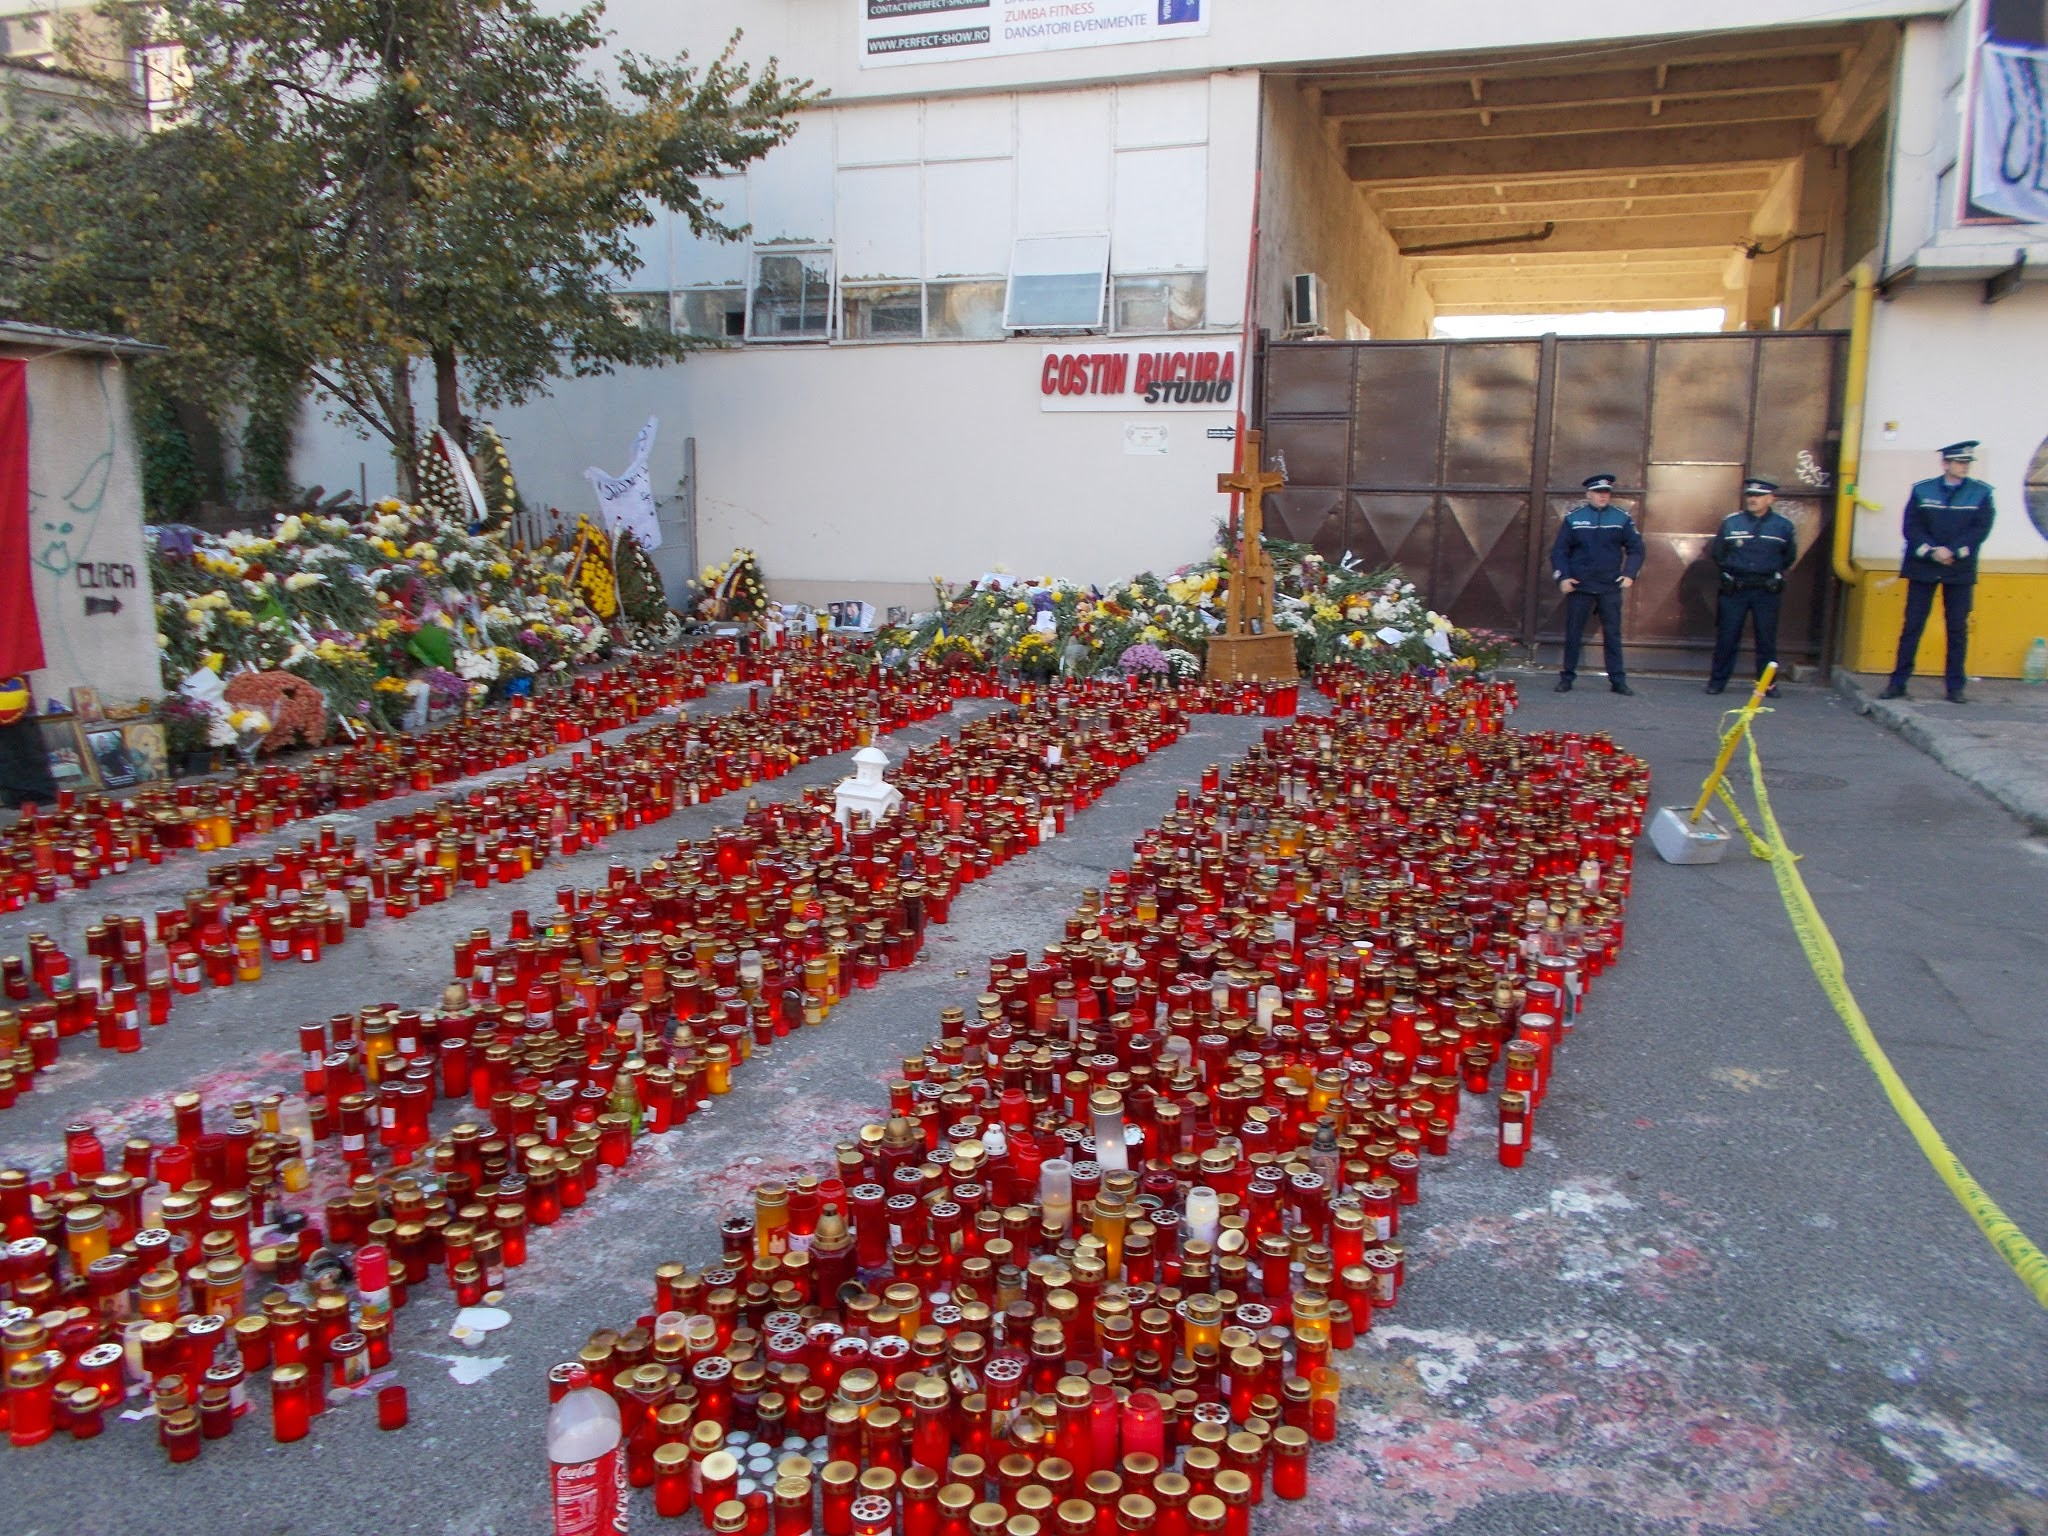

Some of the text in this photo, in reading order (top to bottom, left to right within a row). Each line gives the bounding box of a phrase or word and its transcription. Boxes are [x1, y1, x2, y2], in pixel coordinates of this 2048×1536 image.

[1005, 3, 1095, 23] ZUMBA FITNESS
[1004, 14, 1147, 39] DANSATORI EVENIMENTE
[869, 30, 989, 52] WWW.PERFECT-SHOW.RO
[1041, 351, 1235, 395] COSTIN BUCURA
[1144, 380, 1233, 404] STUDIO
